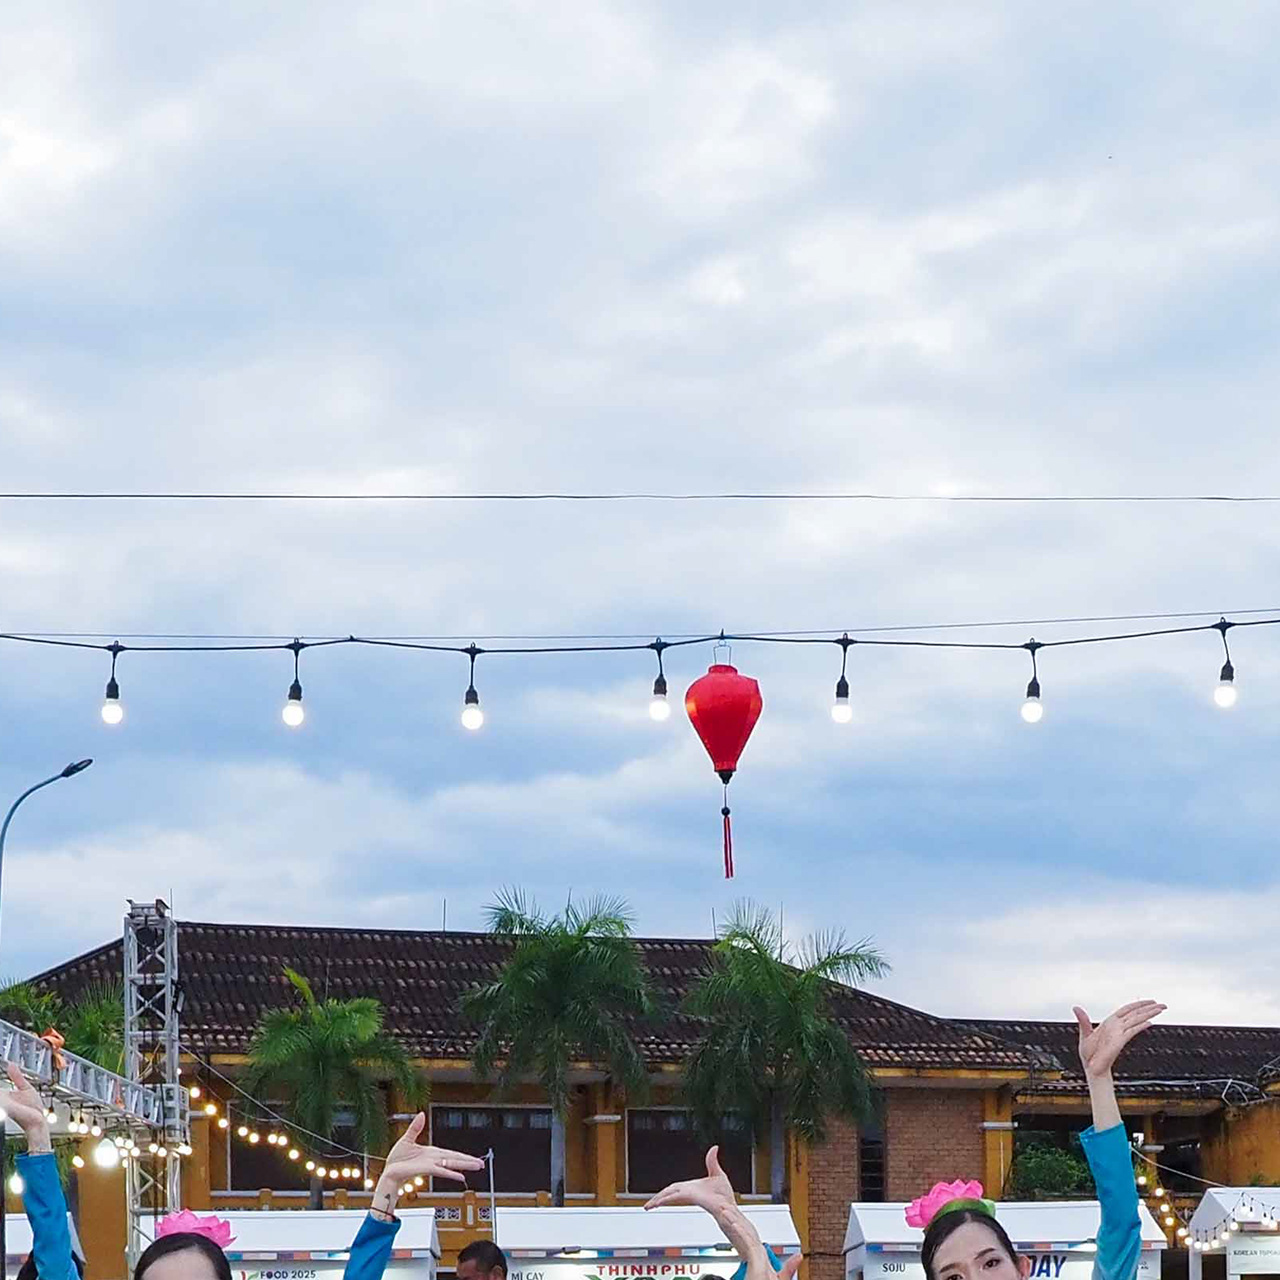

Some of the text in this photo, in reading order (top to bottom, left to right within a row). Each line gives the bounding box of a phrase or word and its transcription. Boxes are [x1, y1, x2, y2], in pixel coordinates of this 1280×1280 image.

[596, 1264, 701, 1276] THINHPHU
[882, 1263, 906, 1273] SOJU
[260, 1270, 317, 1279] FOOD 2025
